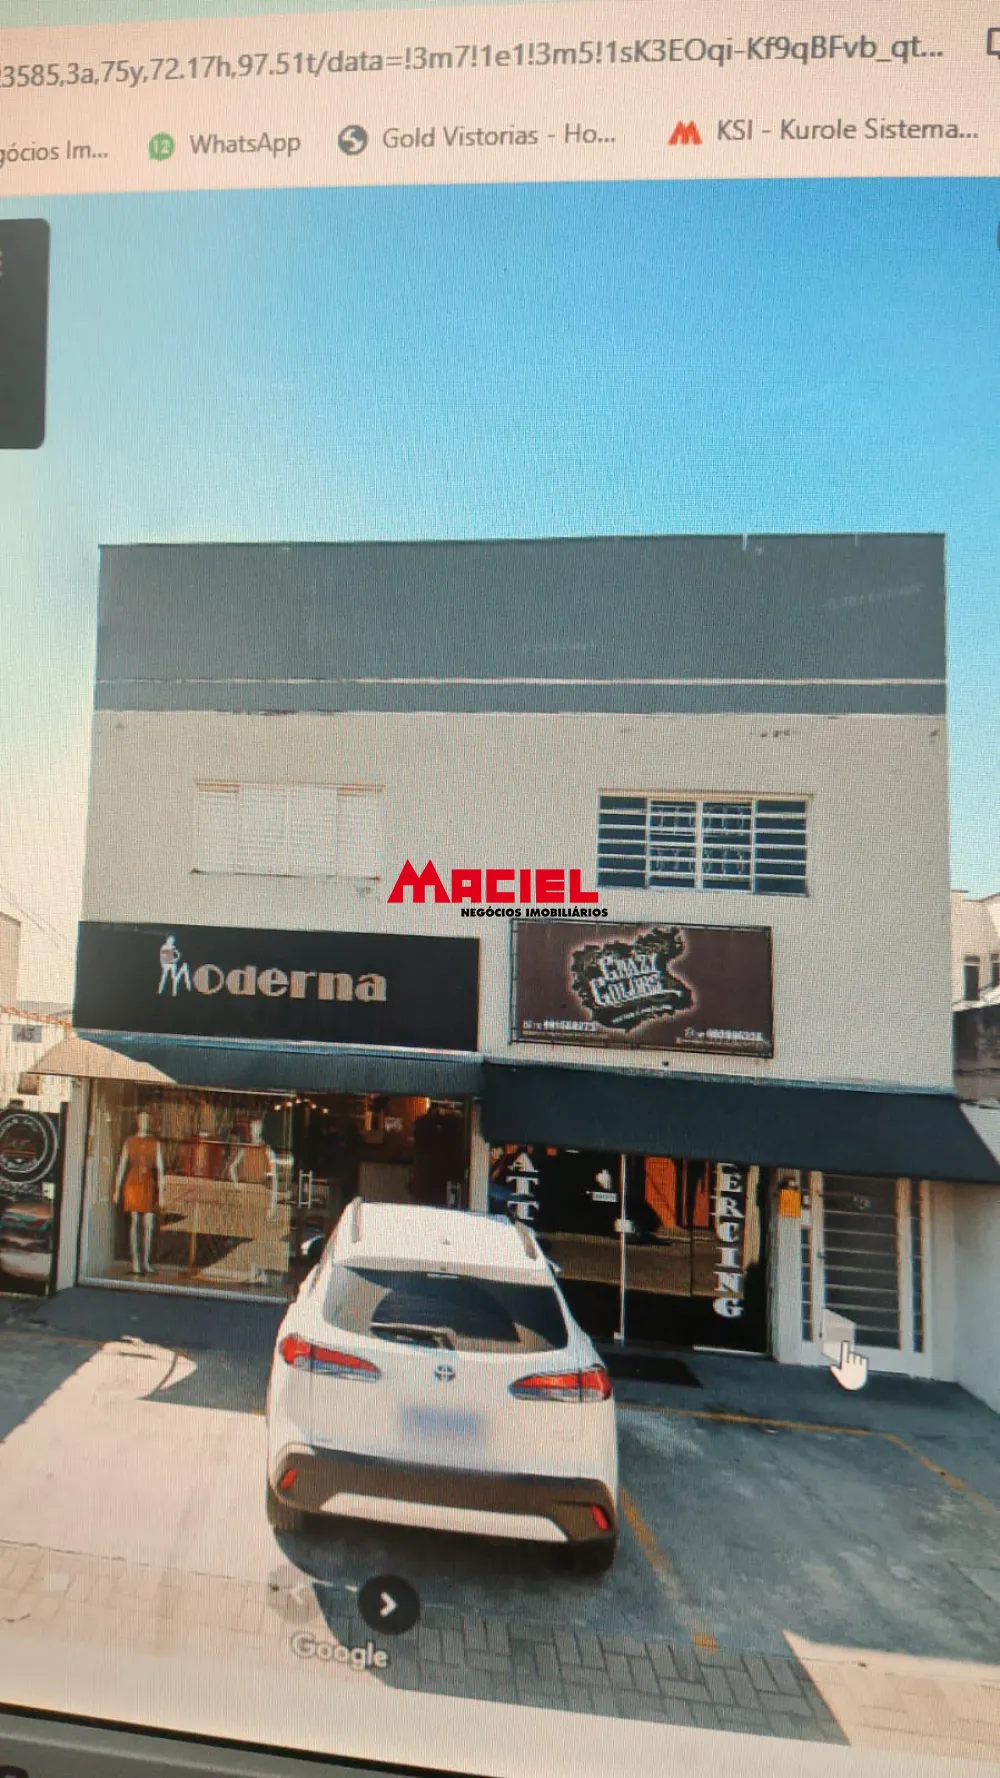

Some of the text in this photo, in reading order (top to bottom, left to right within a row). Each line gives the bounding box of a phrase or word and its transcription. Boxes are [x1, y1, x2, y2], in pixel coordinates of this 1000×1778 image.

[0, 34, 944, 89] 3585,3a,75y,72.17h,97.51t/data=!3m7!1e1!3m5!1sK3EOqi-Kf9qBFvb_qt...
[190, 132, 301, 158] WhatsApp
[382, 126, 436, 149] Gold
[443, 124, 539, 147] Vistorias
[564, 122, 616, 145] Ho...
[717, 119, 753, 140] KSI
[780, 117, 857, 140] Kurole
[864, 117, 979, 139] Sistema...
[66, 139, 109, 160] Im...
[157, 936, 387, 1002] Moderna
[506, 1152, 540, 1221] ATT
[290, 1630, 390, 1672] Google
